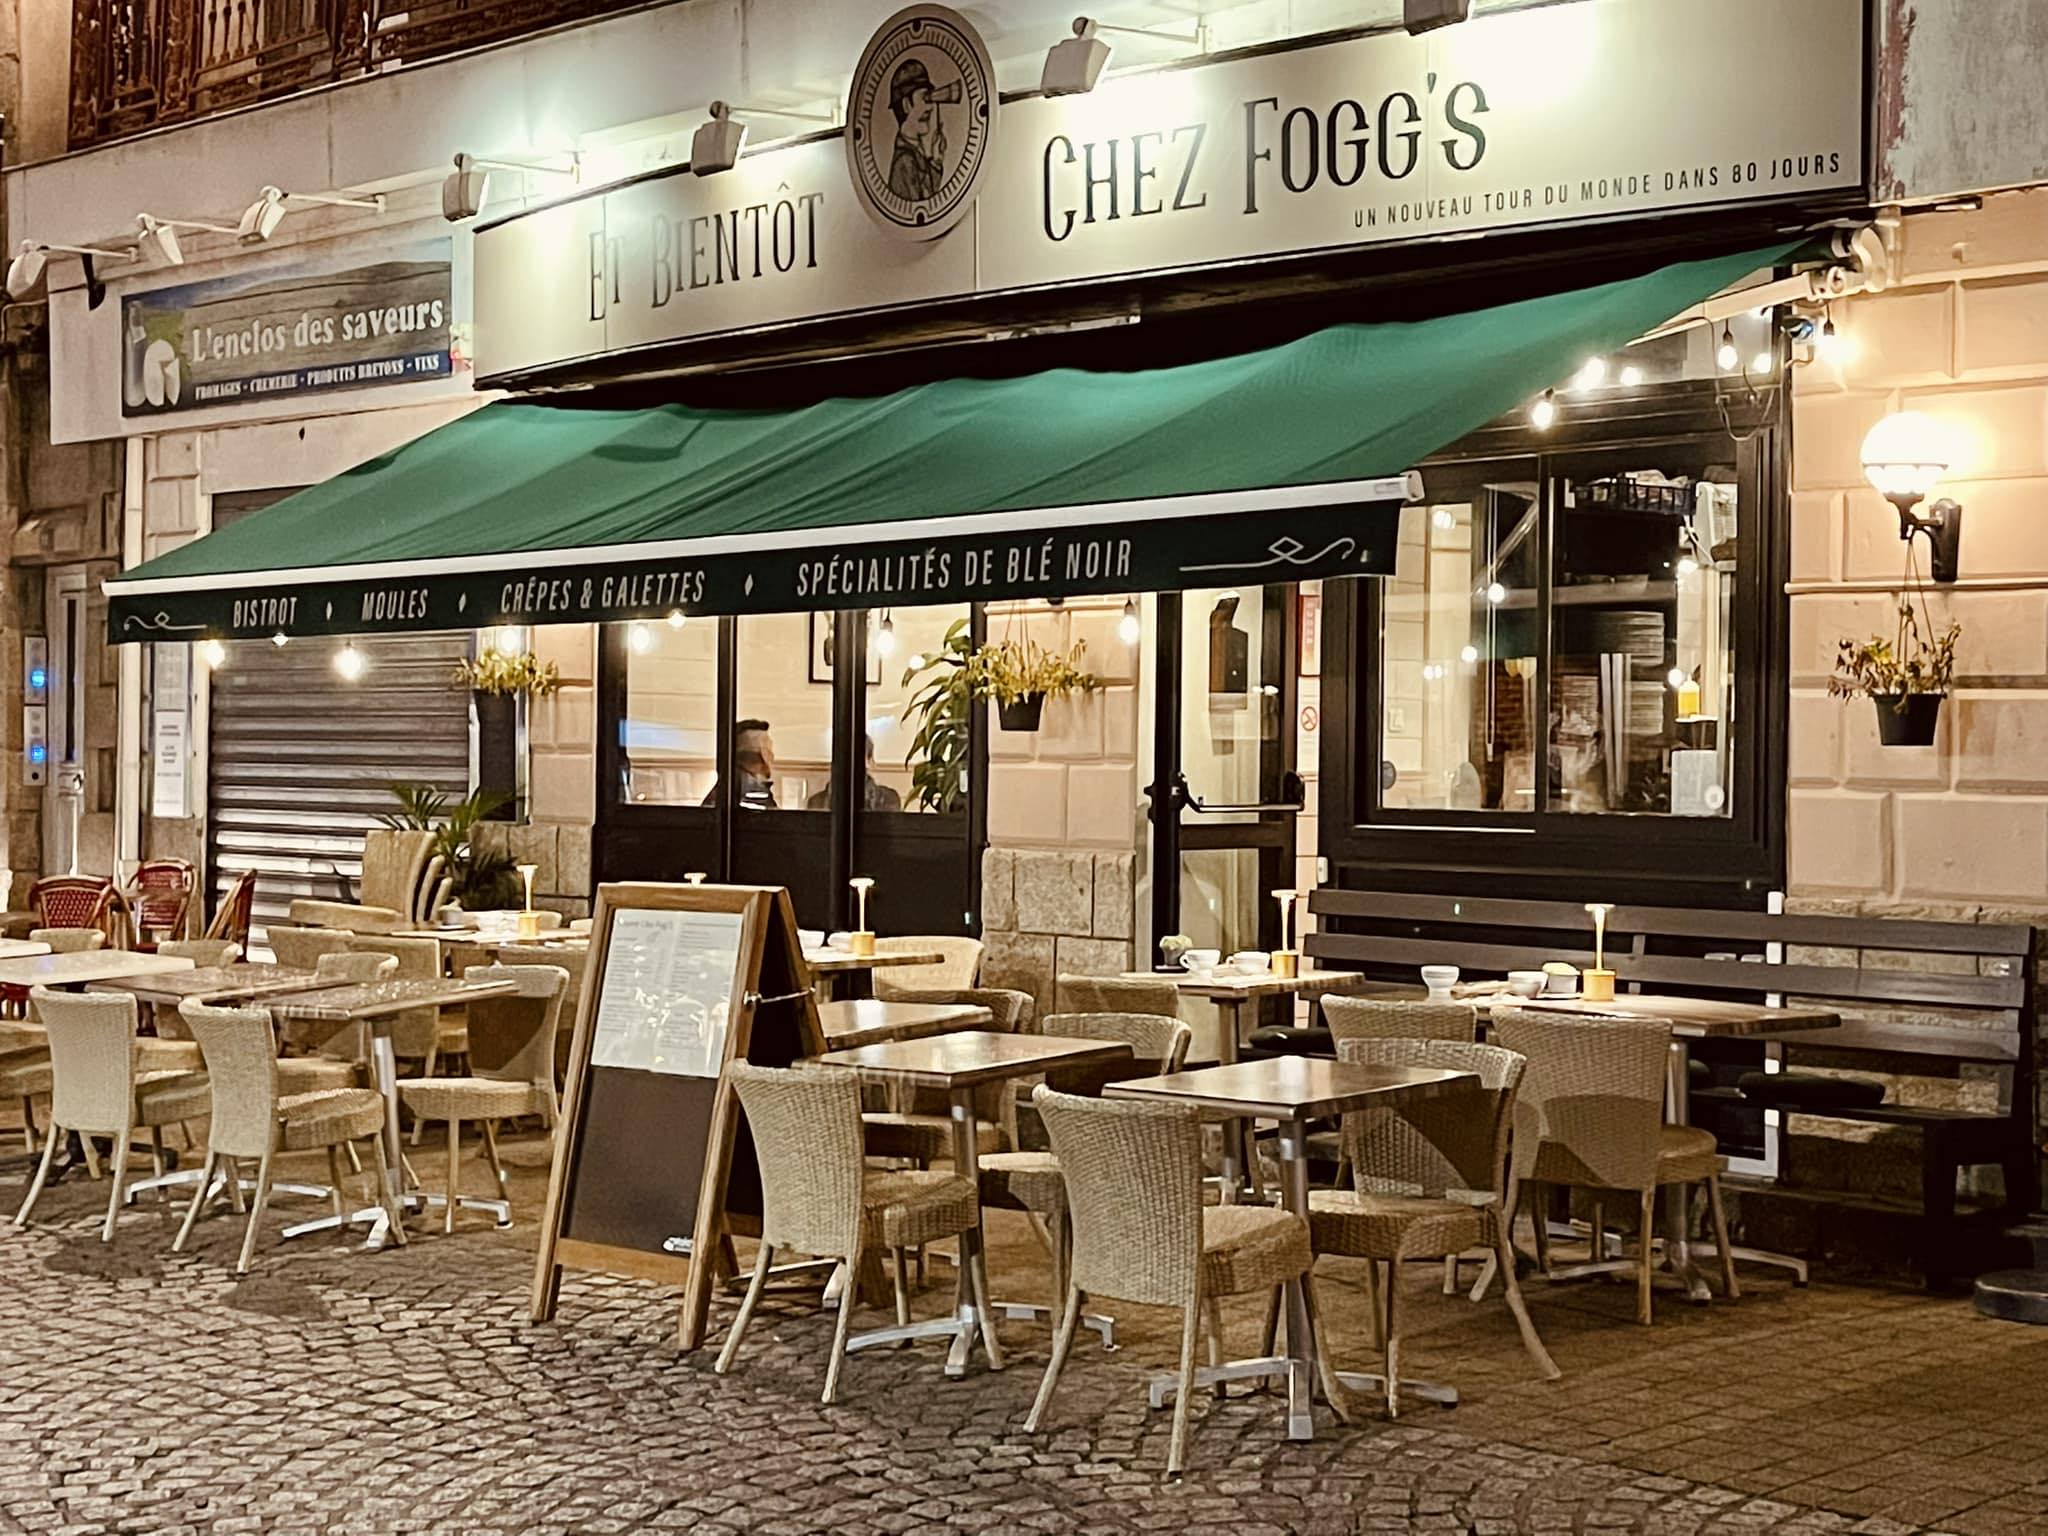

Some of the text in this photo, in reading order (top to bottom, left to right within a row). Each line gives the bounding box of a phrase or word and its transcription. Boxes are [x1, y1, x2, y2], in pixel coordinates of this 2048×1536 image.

[588, 72, 1490, 322] ET BIENTÔT CHEZ FOGG'S
[1354, 152, 1840, 227] UN NOUVEAU TOUR DU MONDE DANS 80 JOURS
[191, 299, 444, 363] L'enclos des saveurs
[195, 381, 241, 400] FROMAGES
[307, 365, 356, 387] PRODUITS
[358, 359, 404, 379] BRETONS
[415, 353, 440, 371] VINS
[233, 537, 1132, 629] BISTROT MOULES CRÊPES & GALETTES SPÉCIALITÉS DE BLÉ NOIR
